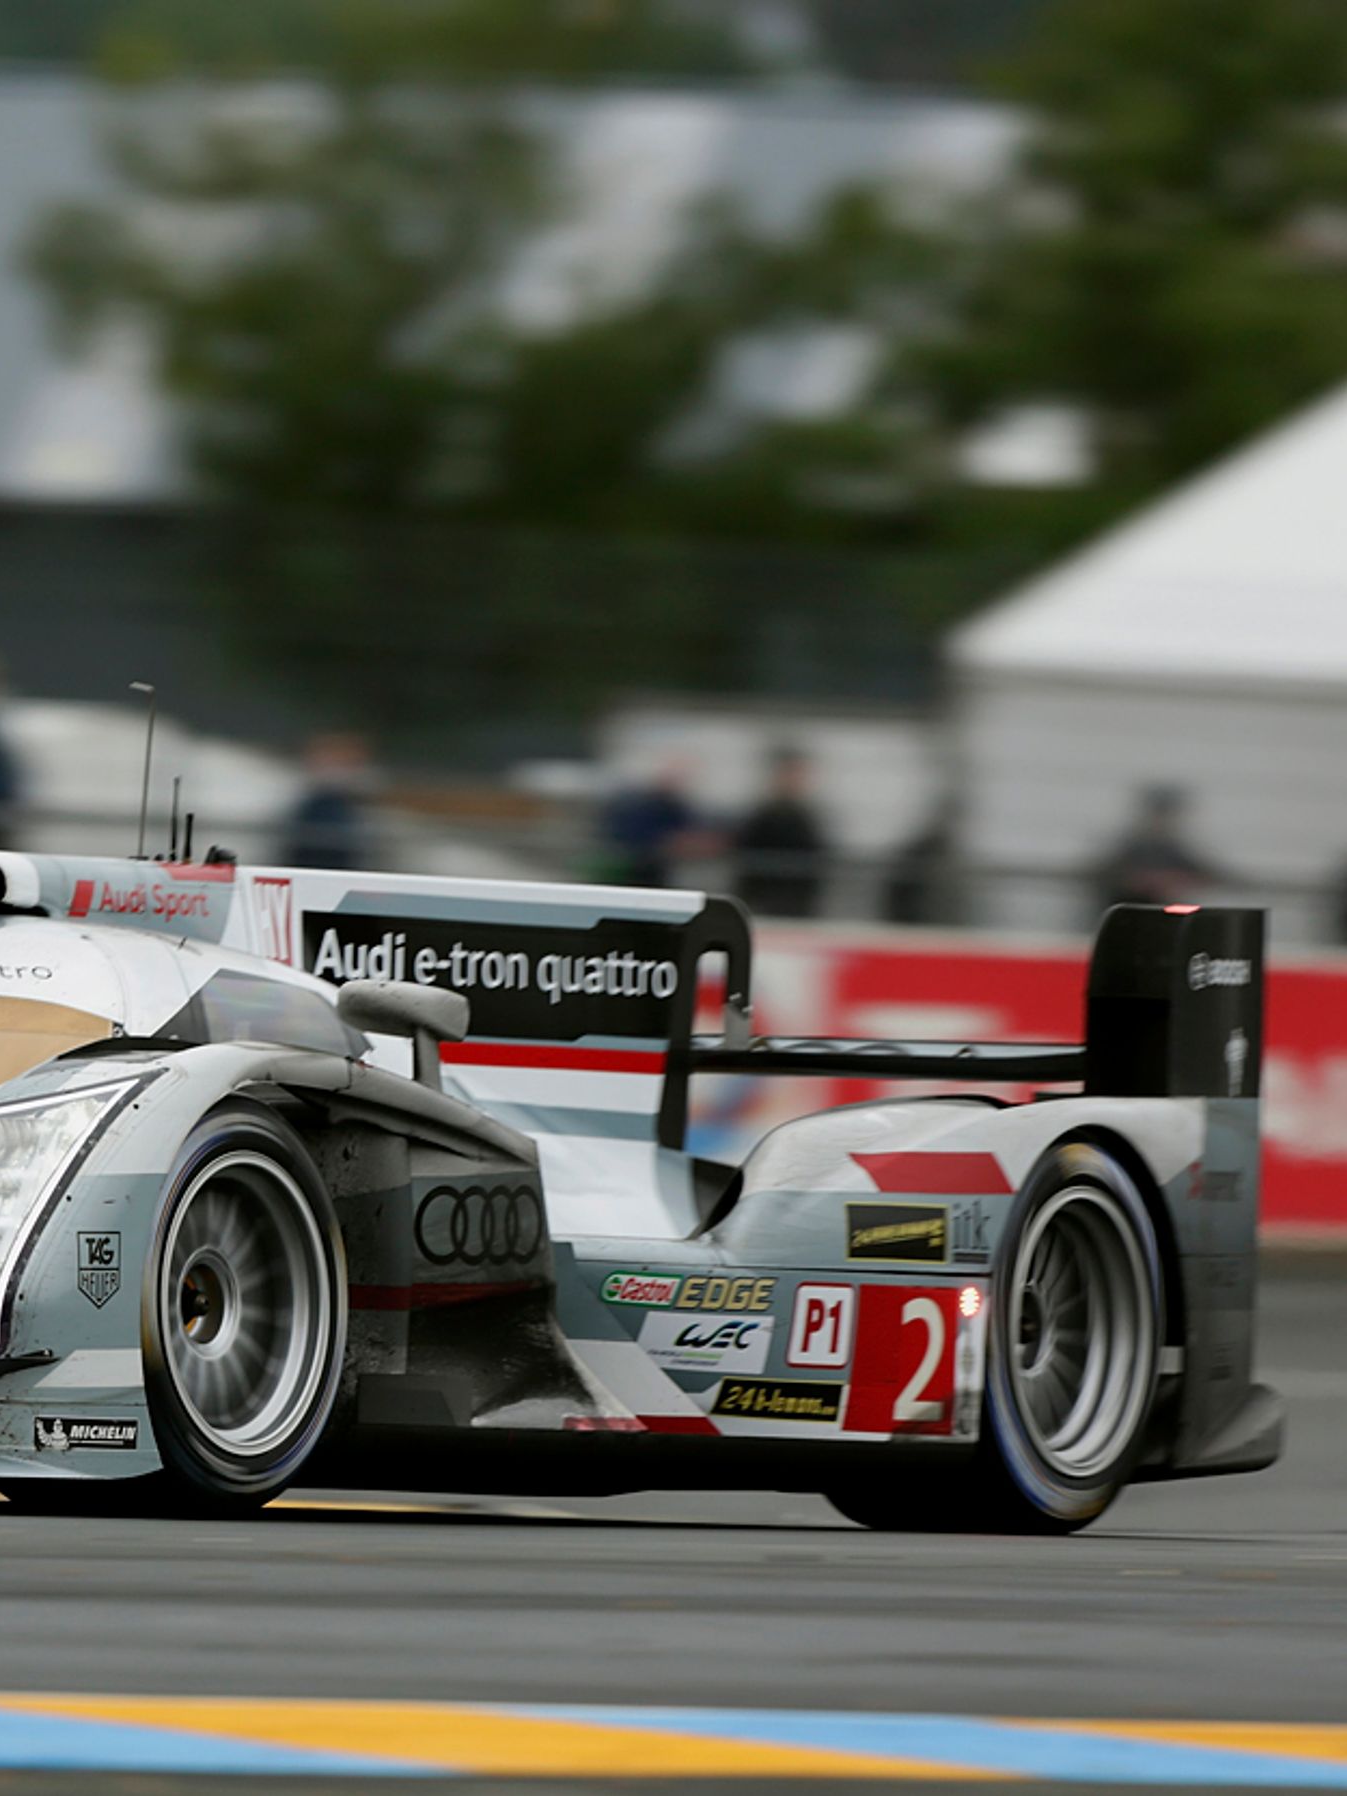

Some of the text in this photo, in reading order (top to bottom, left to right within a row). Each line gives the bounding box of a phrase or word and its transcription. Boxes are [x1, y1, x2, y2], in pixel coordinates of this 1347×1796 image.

[99, 882, 210, 922] Audi Sport
[314, 928, 678, 1005] Audi e-tron quattro
[85, 1237, 115, 1265] TAG
[81, 1271, 118, 1298] HEUER
[619, 1275, 779, 1311] Castrol EDGE
[674, 1320, 760, 1350] WEC
[800, 1298, 843, 1354] P1
[892, 1297, 946, 1422] 2
[69, 1424, 137, 1440] MICHELIN
